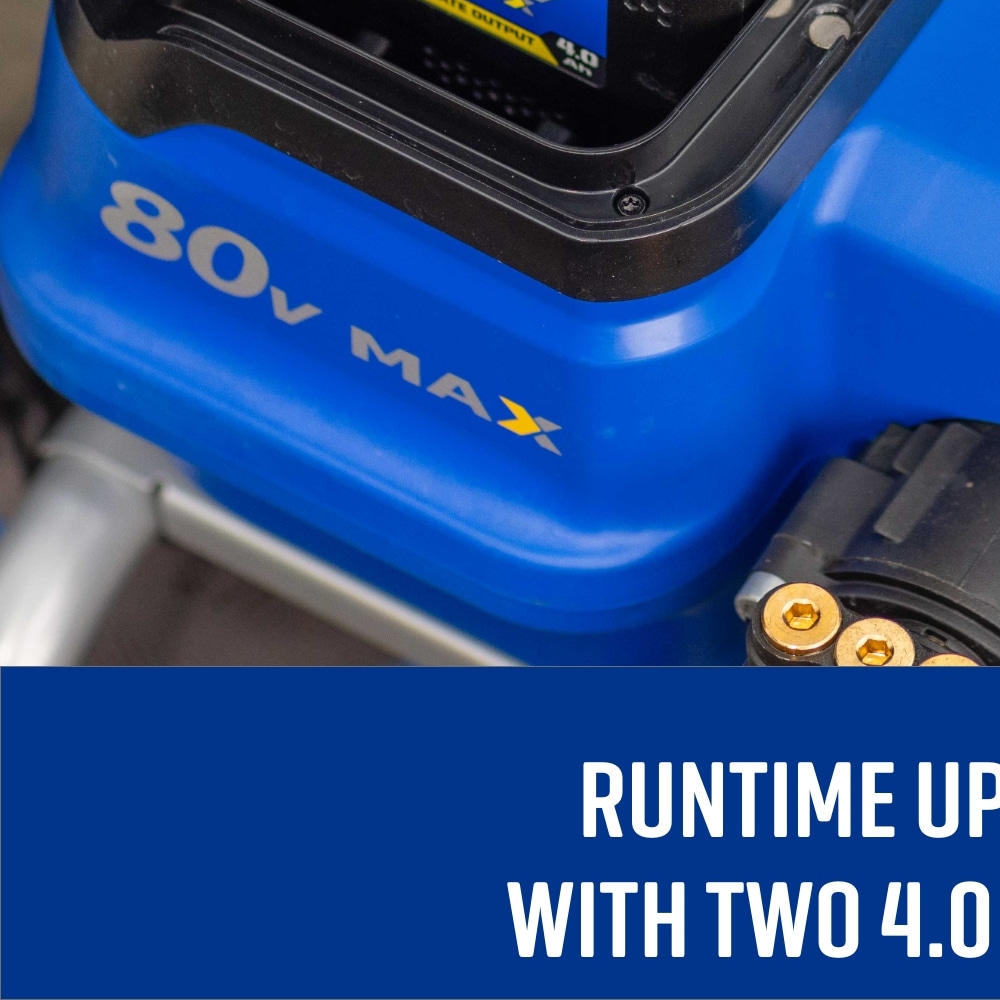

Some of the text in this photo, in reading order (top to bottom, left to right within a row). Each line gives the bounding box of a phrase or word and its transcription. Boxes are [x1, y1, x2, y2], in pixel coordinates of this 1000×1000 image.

[471, 9, 536, 47] OUTPUT
[556, 36, 600, 69] 4.0
[351, 325, 562, 456] MAX
